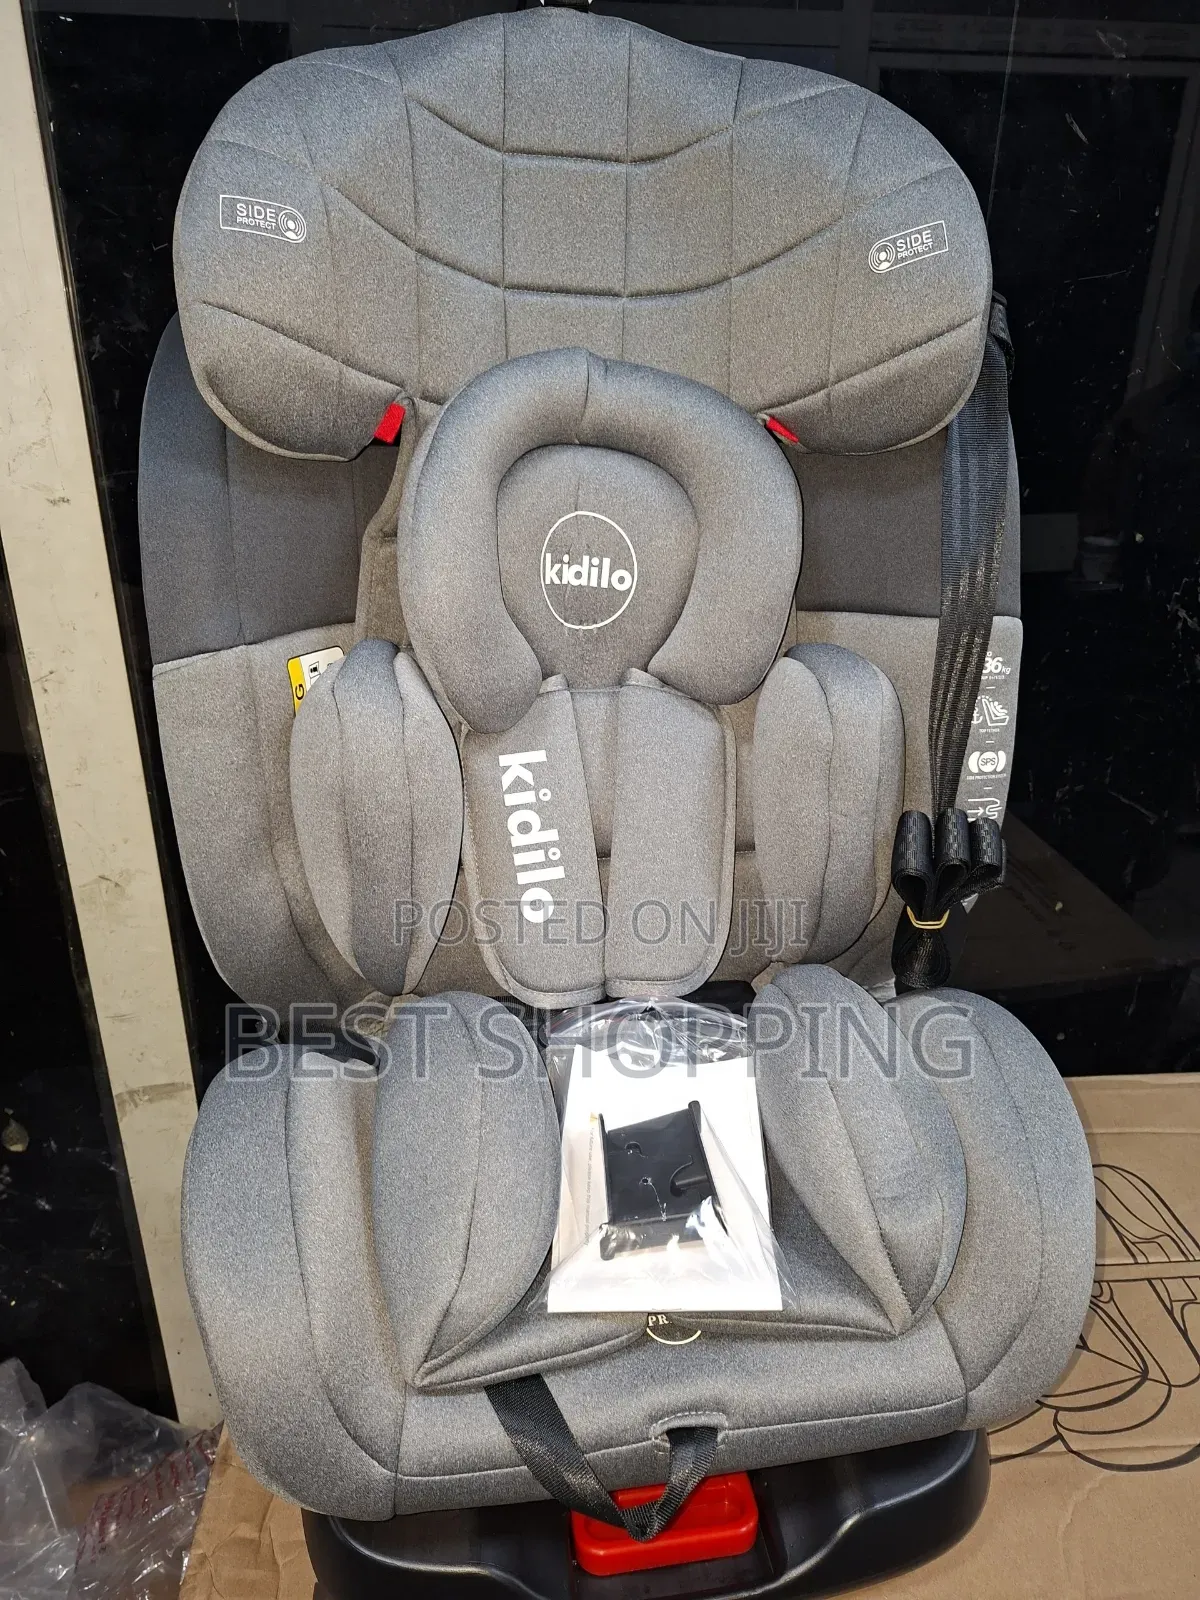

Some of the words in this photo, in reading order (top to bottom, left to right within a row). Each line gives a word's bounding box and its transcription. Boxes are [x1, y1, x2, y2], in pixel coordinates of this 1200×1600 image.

[236, 203, 276, 222] SIDE
[236, 216, 276, 230] PROTECT
[896, 230, 933, 252] SIDE
[897, 242, 933, 259] PROTECT
[545, 553, 632, 591] kidilo
[980, 757, 996, 766] SPS
[499, 750, 565, 923] kidilo
